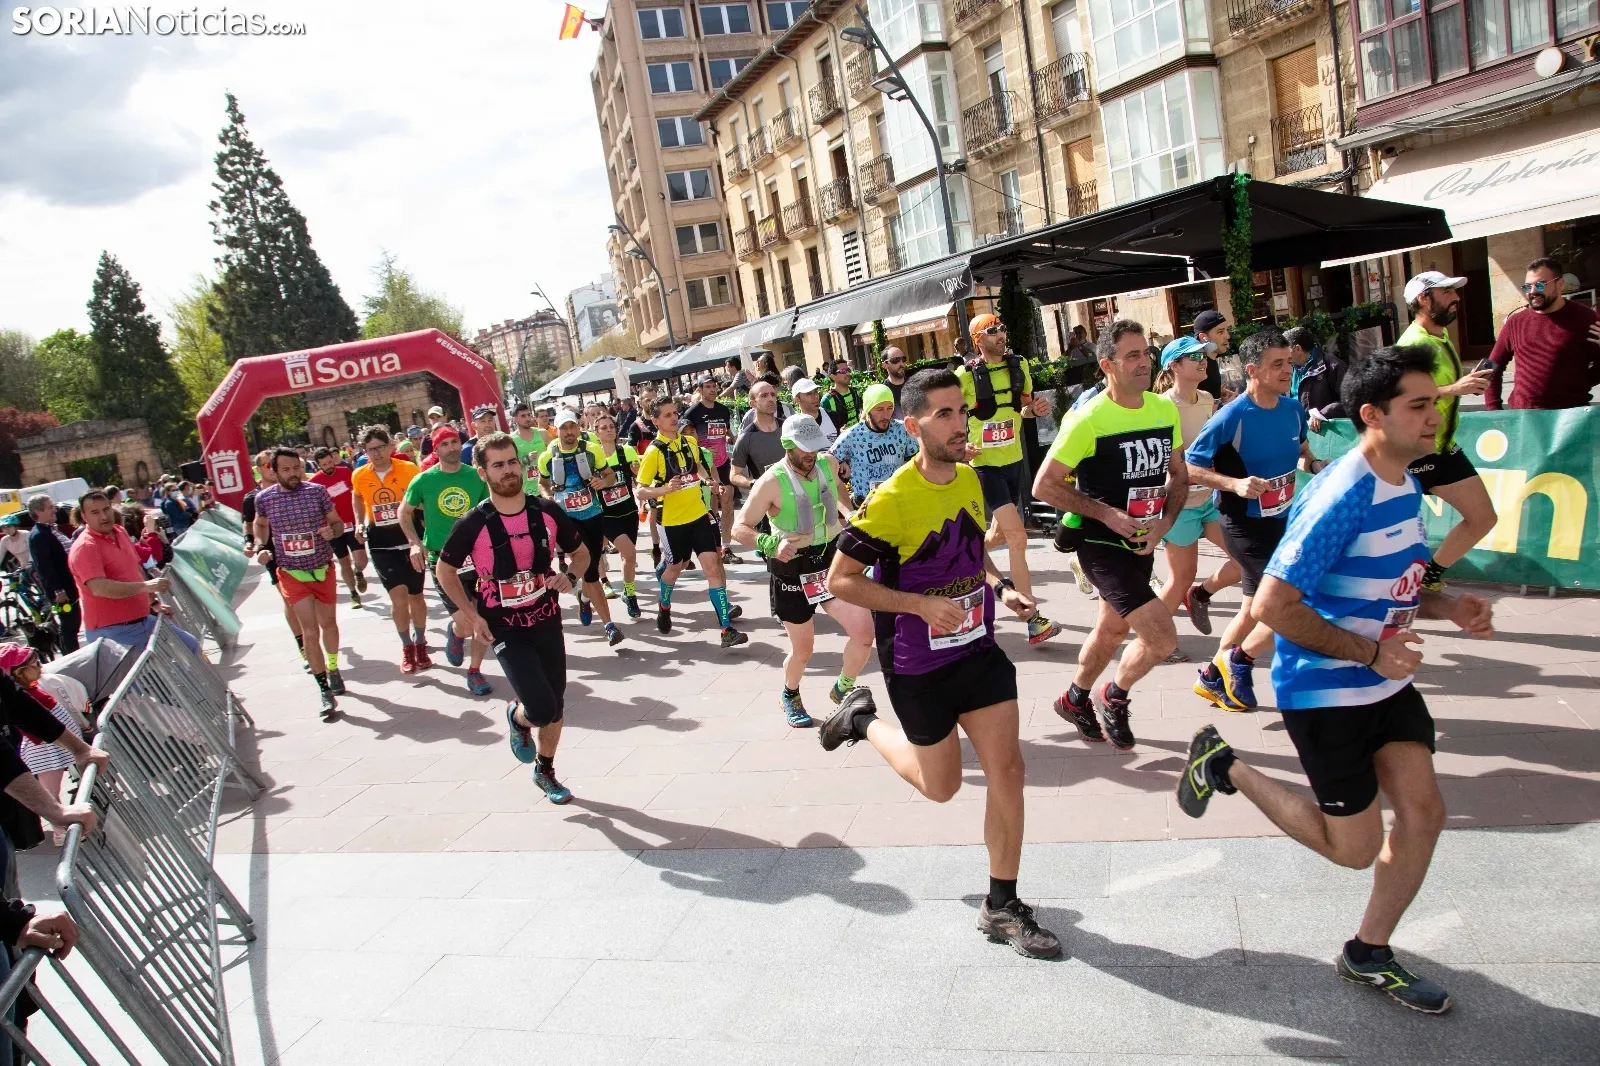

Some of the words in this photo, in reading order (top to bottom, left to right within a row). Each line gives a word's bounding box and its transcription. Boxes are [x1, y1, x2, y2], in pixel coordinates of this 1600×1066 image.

[939, 274, 968, 294] YORK
[315, 352, 402, 384] Soria
[991, 430, 1008, 441] 80
[866, 442, 896, 464] COMO
[1119, 437, 1163, 474] TAD
[569, 494, 589, 507] 119
[611, 488, 621, 500] 47
[1278, 488, 1287, 502] 4
[381, 509, 396, 520] 68
[1145, 500, 1155, 515] 3
[287, 541, 310, 551] 114
[513, 581, 535, 597] 70
